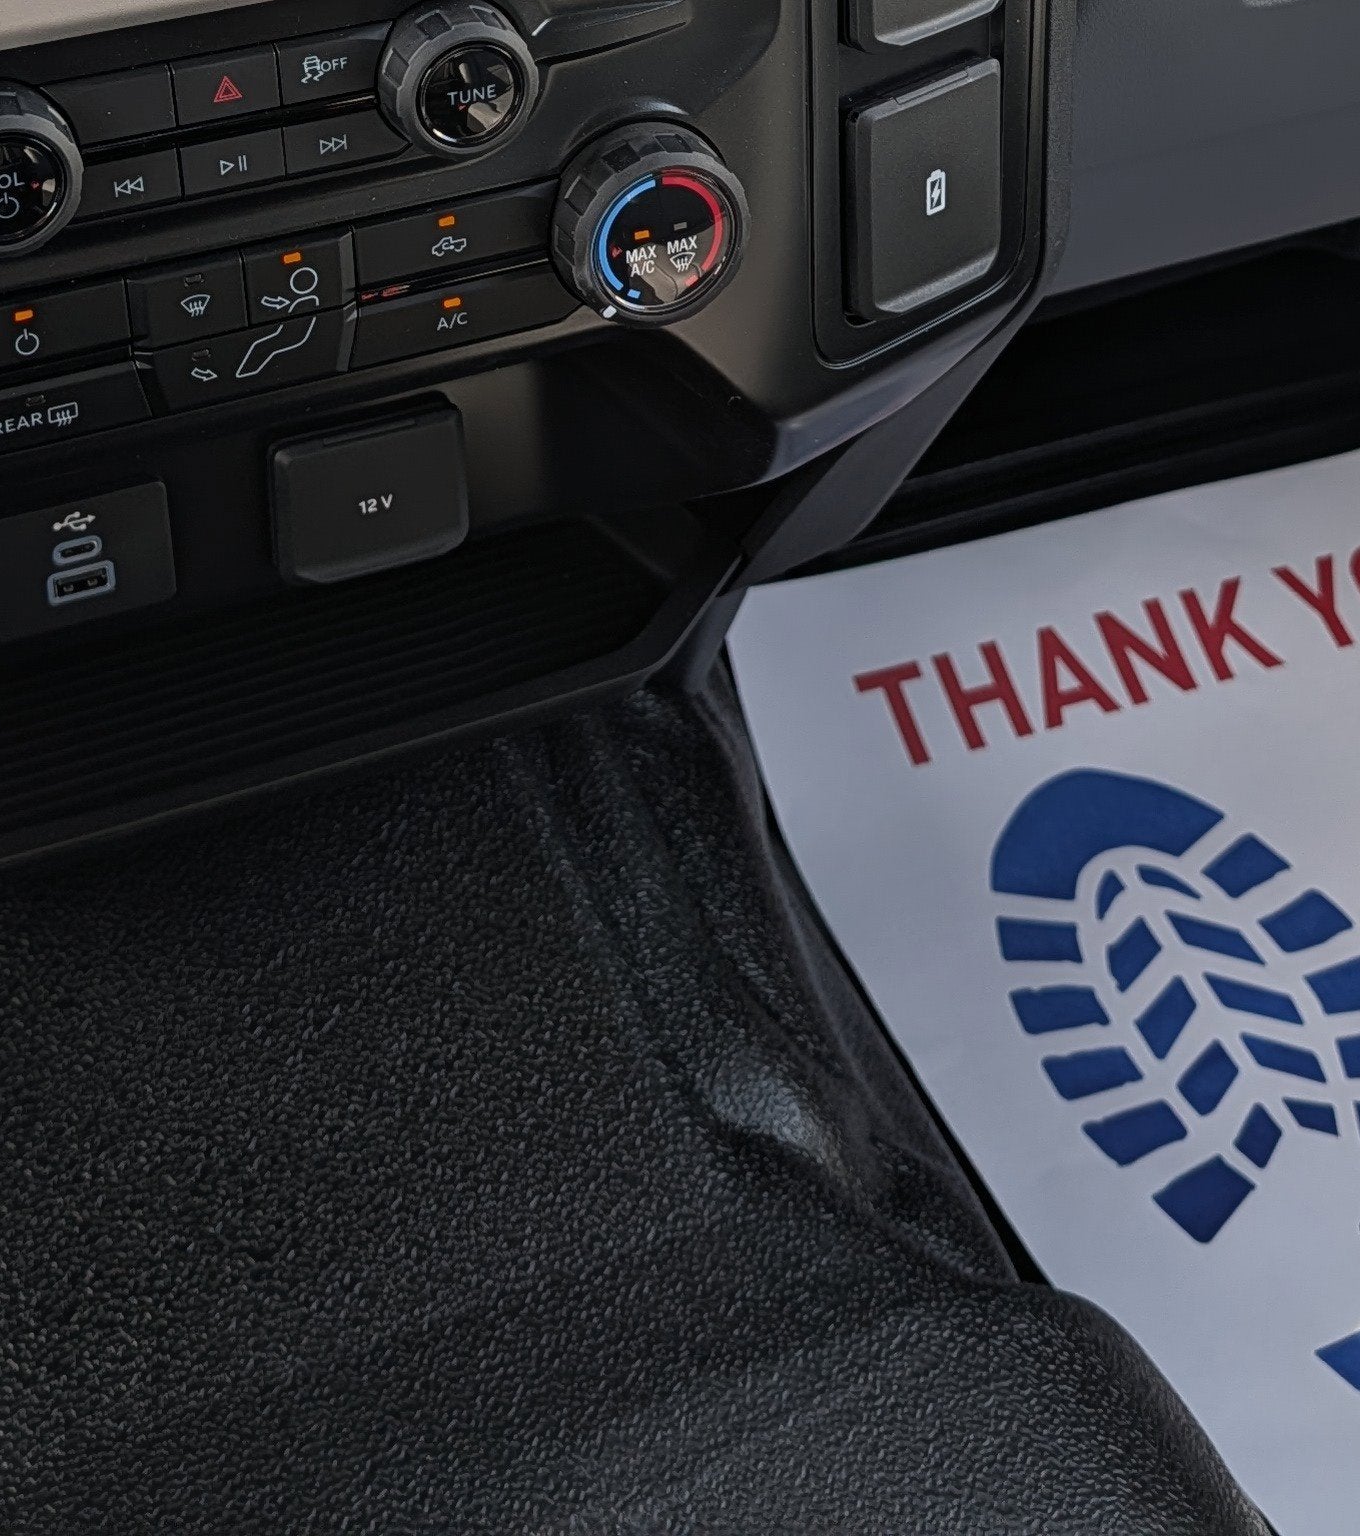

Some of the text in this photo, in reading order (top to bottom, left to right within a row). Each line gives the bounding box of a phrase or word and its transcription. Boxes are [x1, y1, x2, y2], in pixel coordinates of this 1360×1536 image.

[320, 57, 348, 73] OFF
[447, 84, 496, 106] TUNE
[626, 245, 657, 264] MAX
[667, 235, 698, 254] MAX
[630, 260, 655, 277] A/C
[436, 309, 469, 332] A/C
[358, 493, 394, 515] 12 V
[854, 577, 1284, 768] THANK
